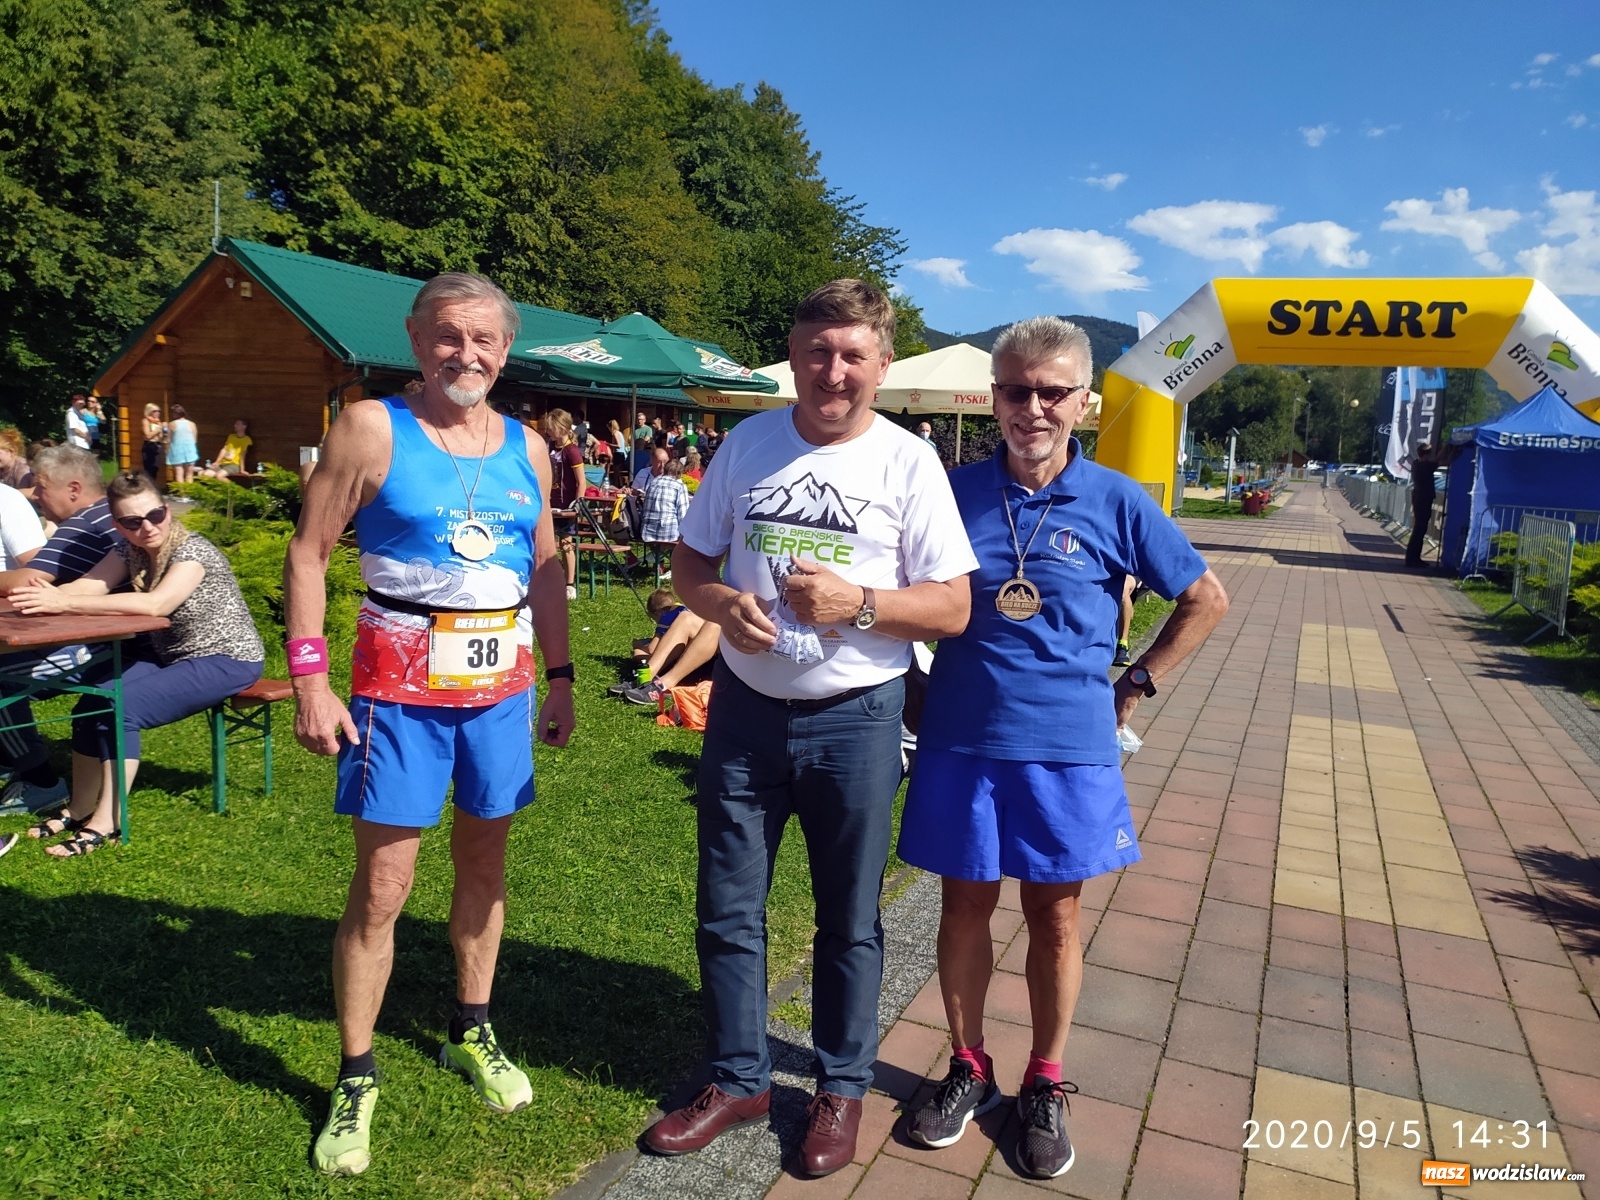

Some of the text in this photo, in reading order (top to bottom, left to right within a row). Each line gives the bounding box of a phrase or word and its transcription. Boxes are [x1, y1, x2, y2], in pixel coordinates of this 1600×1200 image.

[1266, 299, 1468, 339] START
[1162, 341, 1225, 391] Brenna
[1169, 360, 1188, 376] Gmina
[706, 395, 732, 405] TYSKIE
[953, 394, 990, 405] TYSKIE
[435, 506, 447, 518] 7.
[434, 533, 445, 544] W
[752, 523, 844, 543] BIEG O BREŃSKIE
[744, 531, 855, 565] KIERPCE
[467, 637, 499, 669] 38
